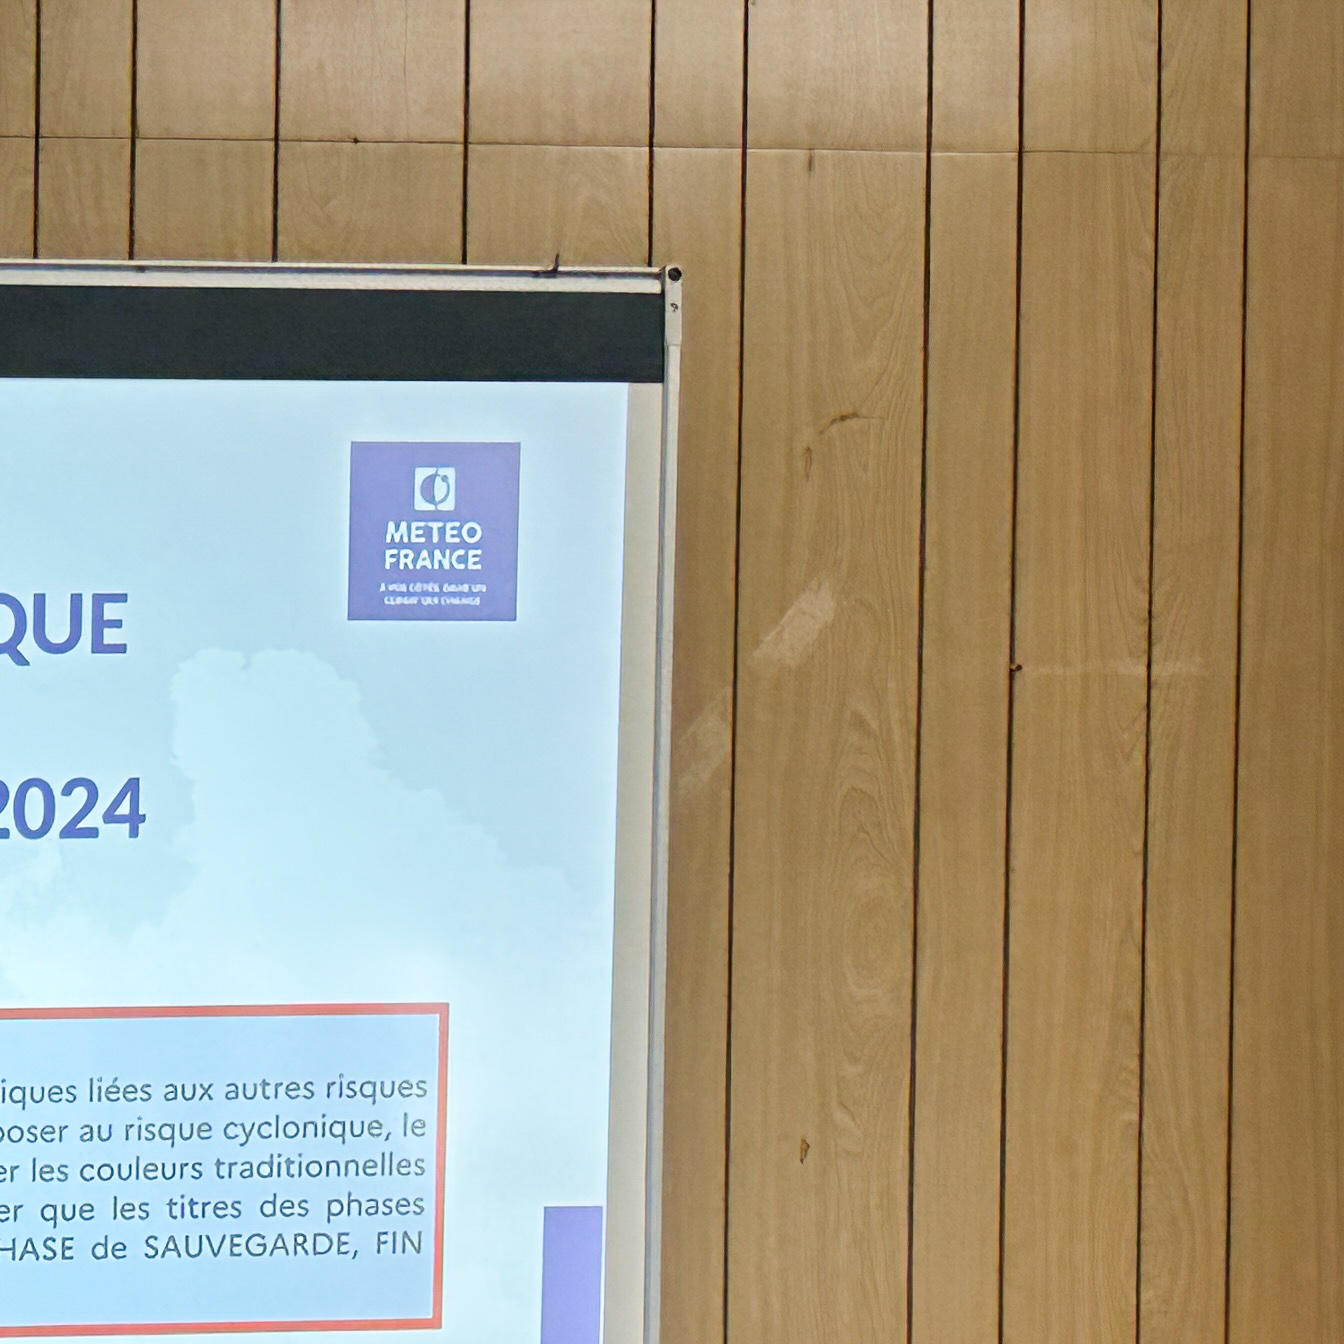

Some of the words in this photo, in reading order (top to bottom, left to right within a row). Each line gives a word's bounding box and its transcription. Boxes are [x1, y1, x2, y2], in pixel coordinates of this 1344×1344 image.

[385, 520, 483, 544] METEO
[384, 548, 483, 570] FRANCE
[89, 1076, 152, 1103] liées
[163, 1082, 214, 1102] aux
[224, 1078, 315, 1101] autres
[326, 1072, 428, 1106] risques
[79, 1123, 113, 1143] au
[124, 1115, 213, 1149] risque
[223, 1113, 392, 1148] cyclonique,
[403, 1111, 427, 1138] le
[31, 1156, 69, 1183] les
[79, 1155, 203, 1183] couleurs
[214, 1150, 426, 1180] traditionnelles
[40, 1202, 95, 1230] que
[112, 1195, 150, 1221] les
[165, 1193, 242, 1221] titres
[259, 1192, 310, 1218] des
[326, 1190, 425, 1225] phases
[91, 1234, 127, 1261] de
[144, 1231, 359, 1260] SAUVEGARDE,
[376, 1230, 422, 1255] FIN
